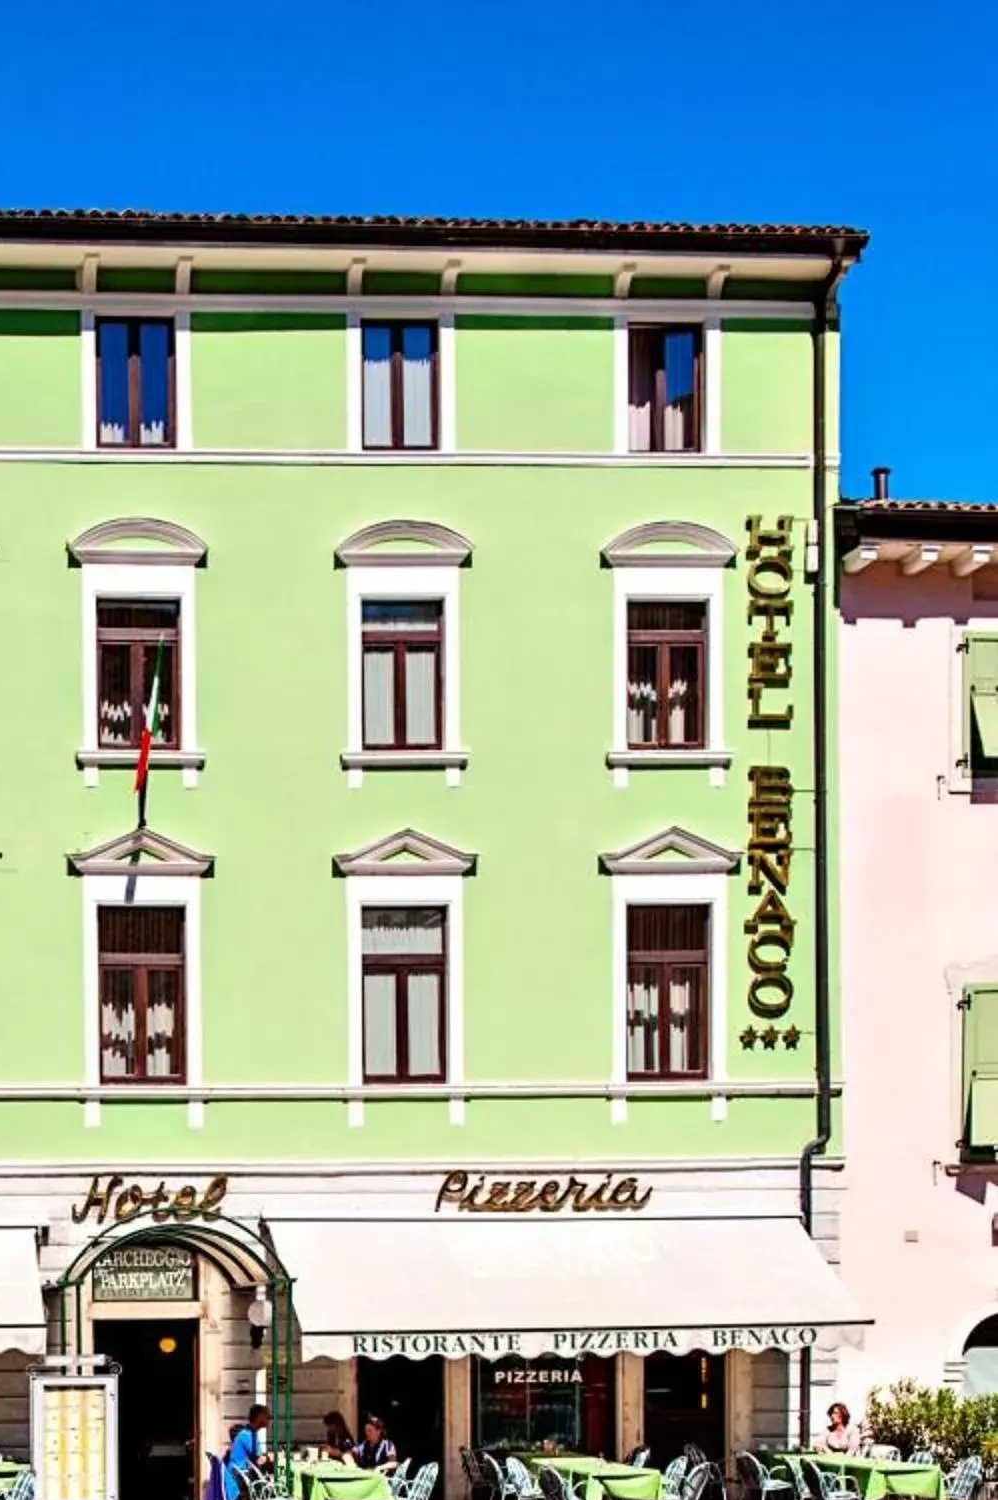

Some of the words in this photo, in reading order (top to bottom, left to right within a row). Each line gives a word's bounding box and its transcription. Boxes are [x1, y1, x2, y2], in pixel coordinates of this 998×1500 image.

[745, 514, 794, 730] HOTEL
[744, 766, 796, 1019] BENACO
[71, 1174, 228, 1225] Hotel
[434, 1170, 653, 1212] Pizzeria
[96, 1249, 192, 1268] ARCHEGGIO
[101, 1270, 187, 1289] PARKPLATZ
[353, 1333, 521, 1354] RISTORANTE
[553, 1330, 679, 1350] PIZZERIA
[713, 1327, 818, 1348] BENACO
[494, 1369, 583, 1384] PIZZERIA
